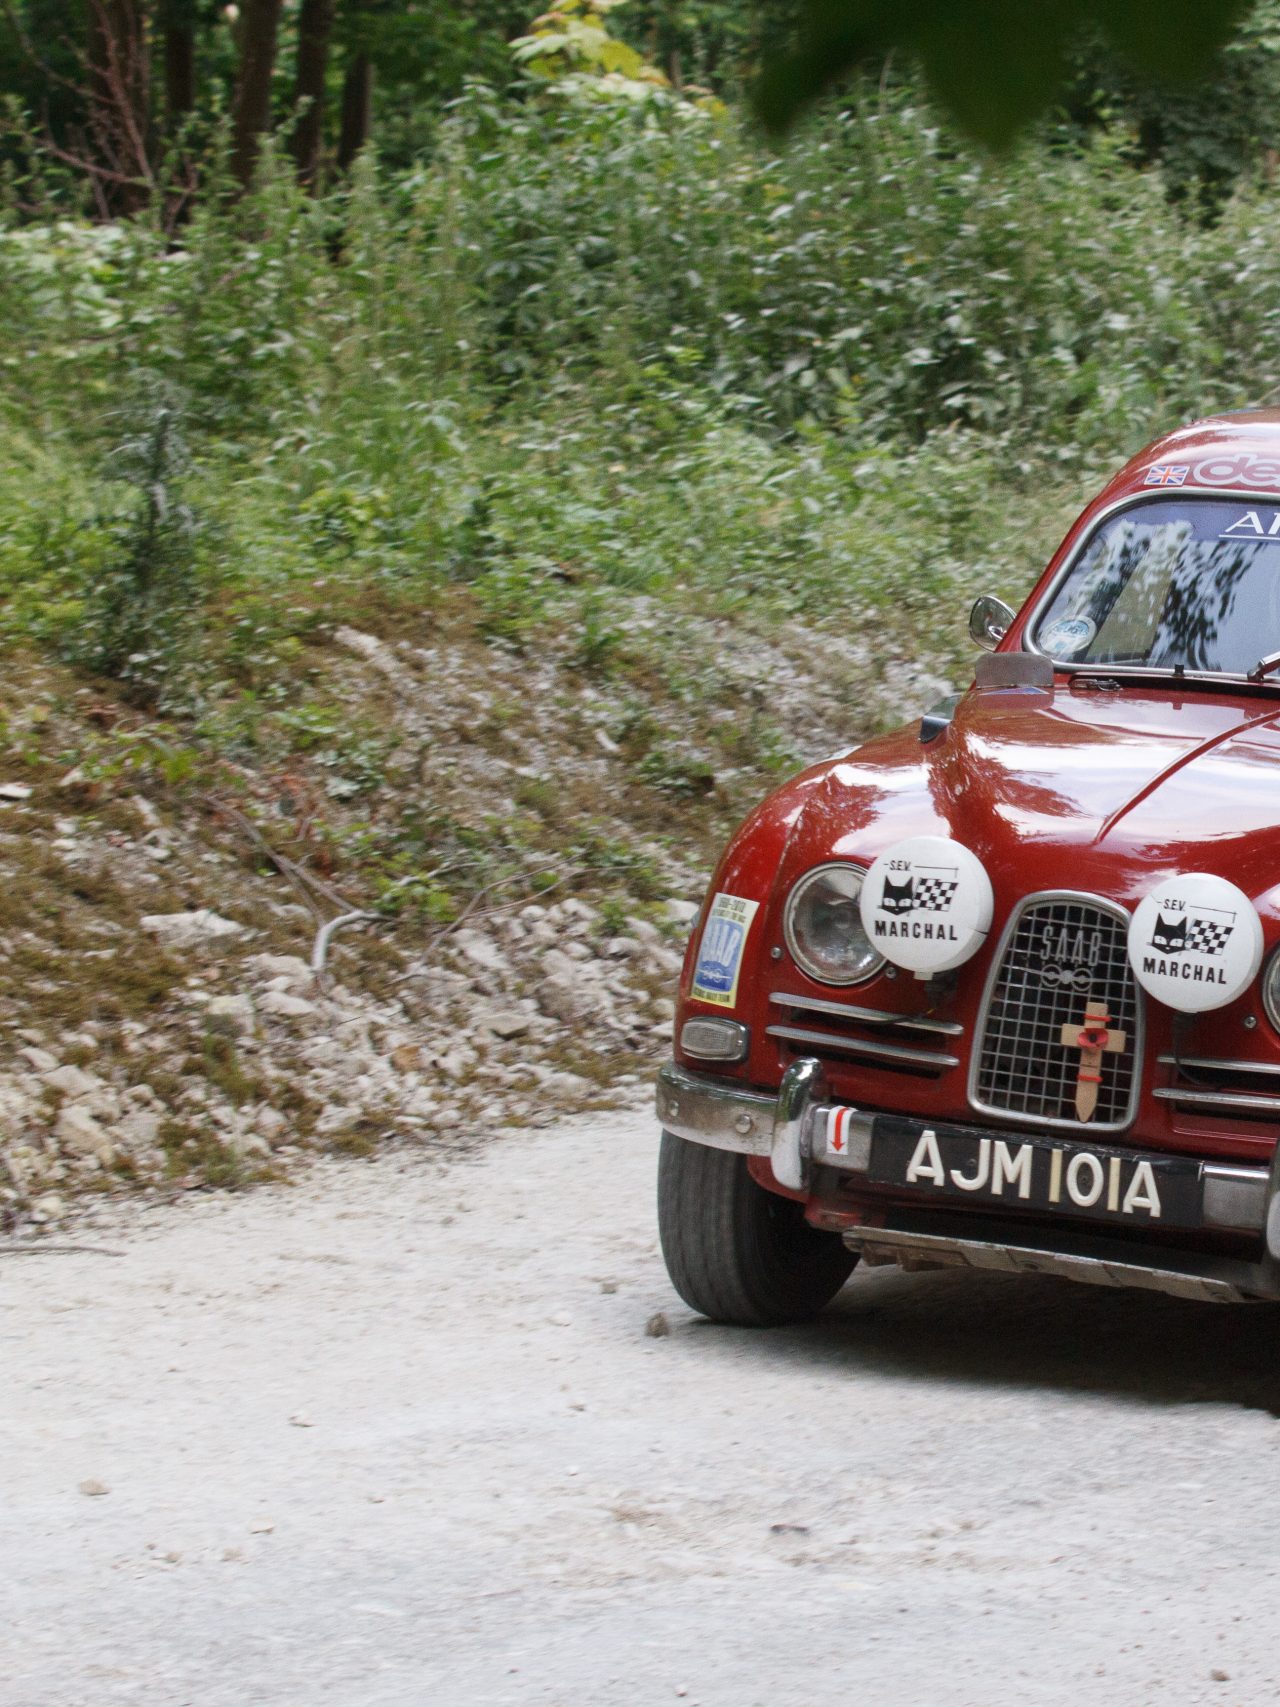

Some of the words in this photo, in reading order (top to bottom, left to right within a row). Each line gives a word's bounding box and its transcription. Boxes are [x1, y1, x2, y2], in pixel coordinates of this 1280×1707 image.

[875, 920, 958, 941] MARCHAL
[1040, 925, 1102, 967] SAAB
[1143, 957, 1227, 985] MARCHAL
[905, 1129, 1034, 1199] AJM
[1048, 1148, 1162, 1218] 101A
